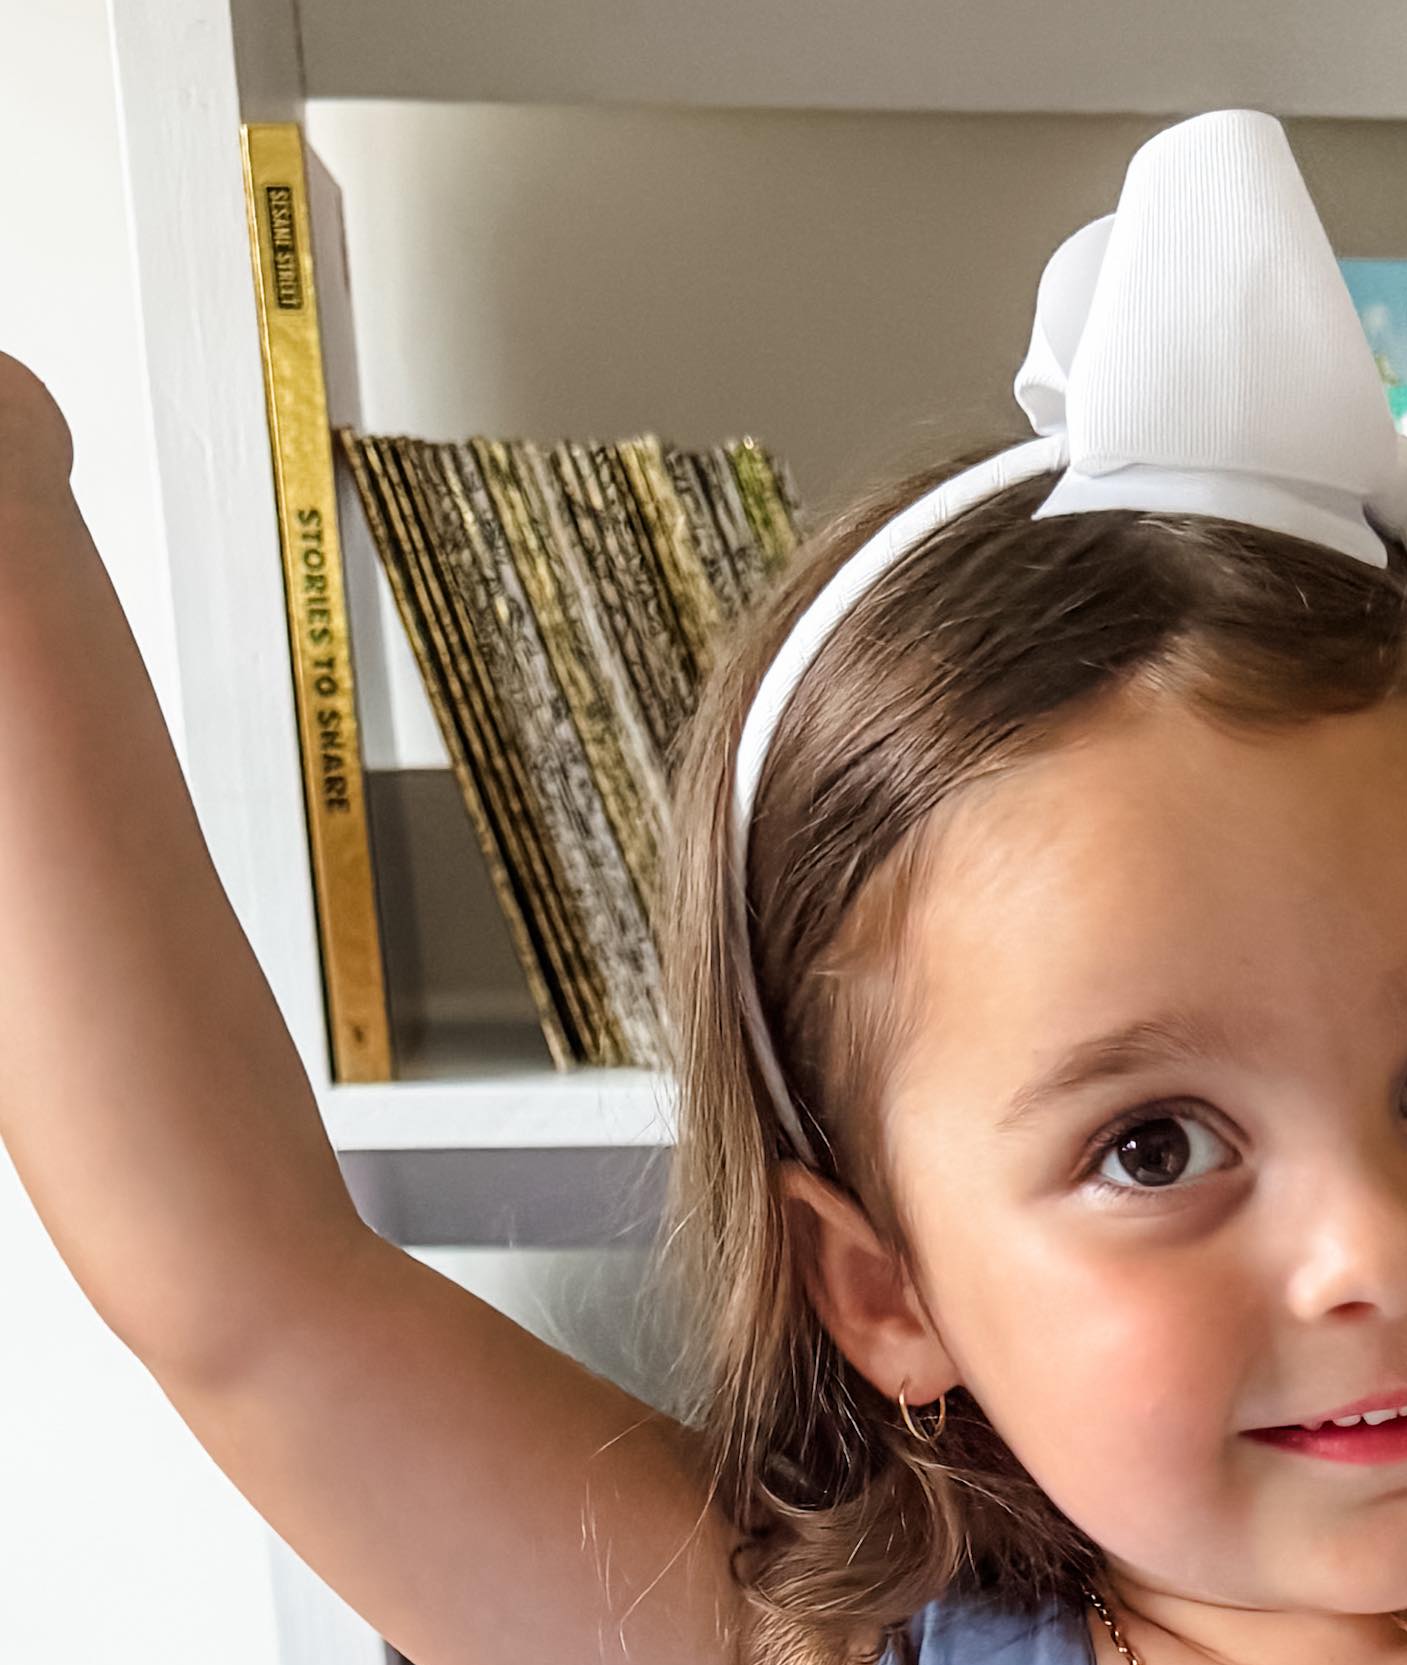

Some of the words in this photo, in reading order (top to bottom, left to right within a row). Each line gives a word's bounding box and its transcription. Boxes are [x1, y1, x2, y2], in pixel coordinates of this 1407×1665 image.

[270, 189, 295, 249] SESAME
[274, 251, 300, 307] STREET
[297, 508, 333, 647] STORIES
[312, 656, 338, 698] TO
[317, 709, 351, 813] SHARE
